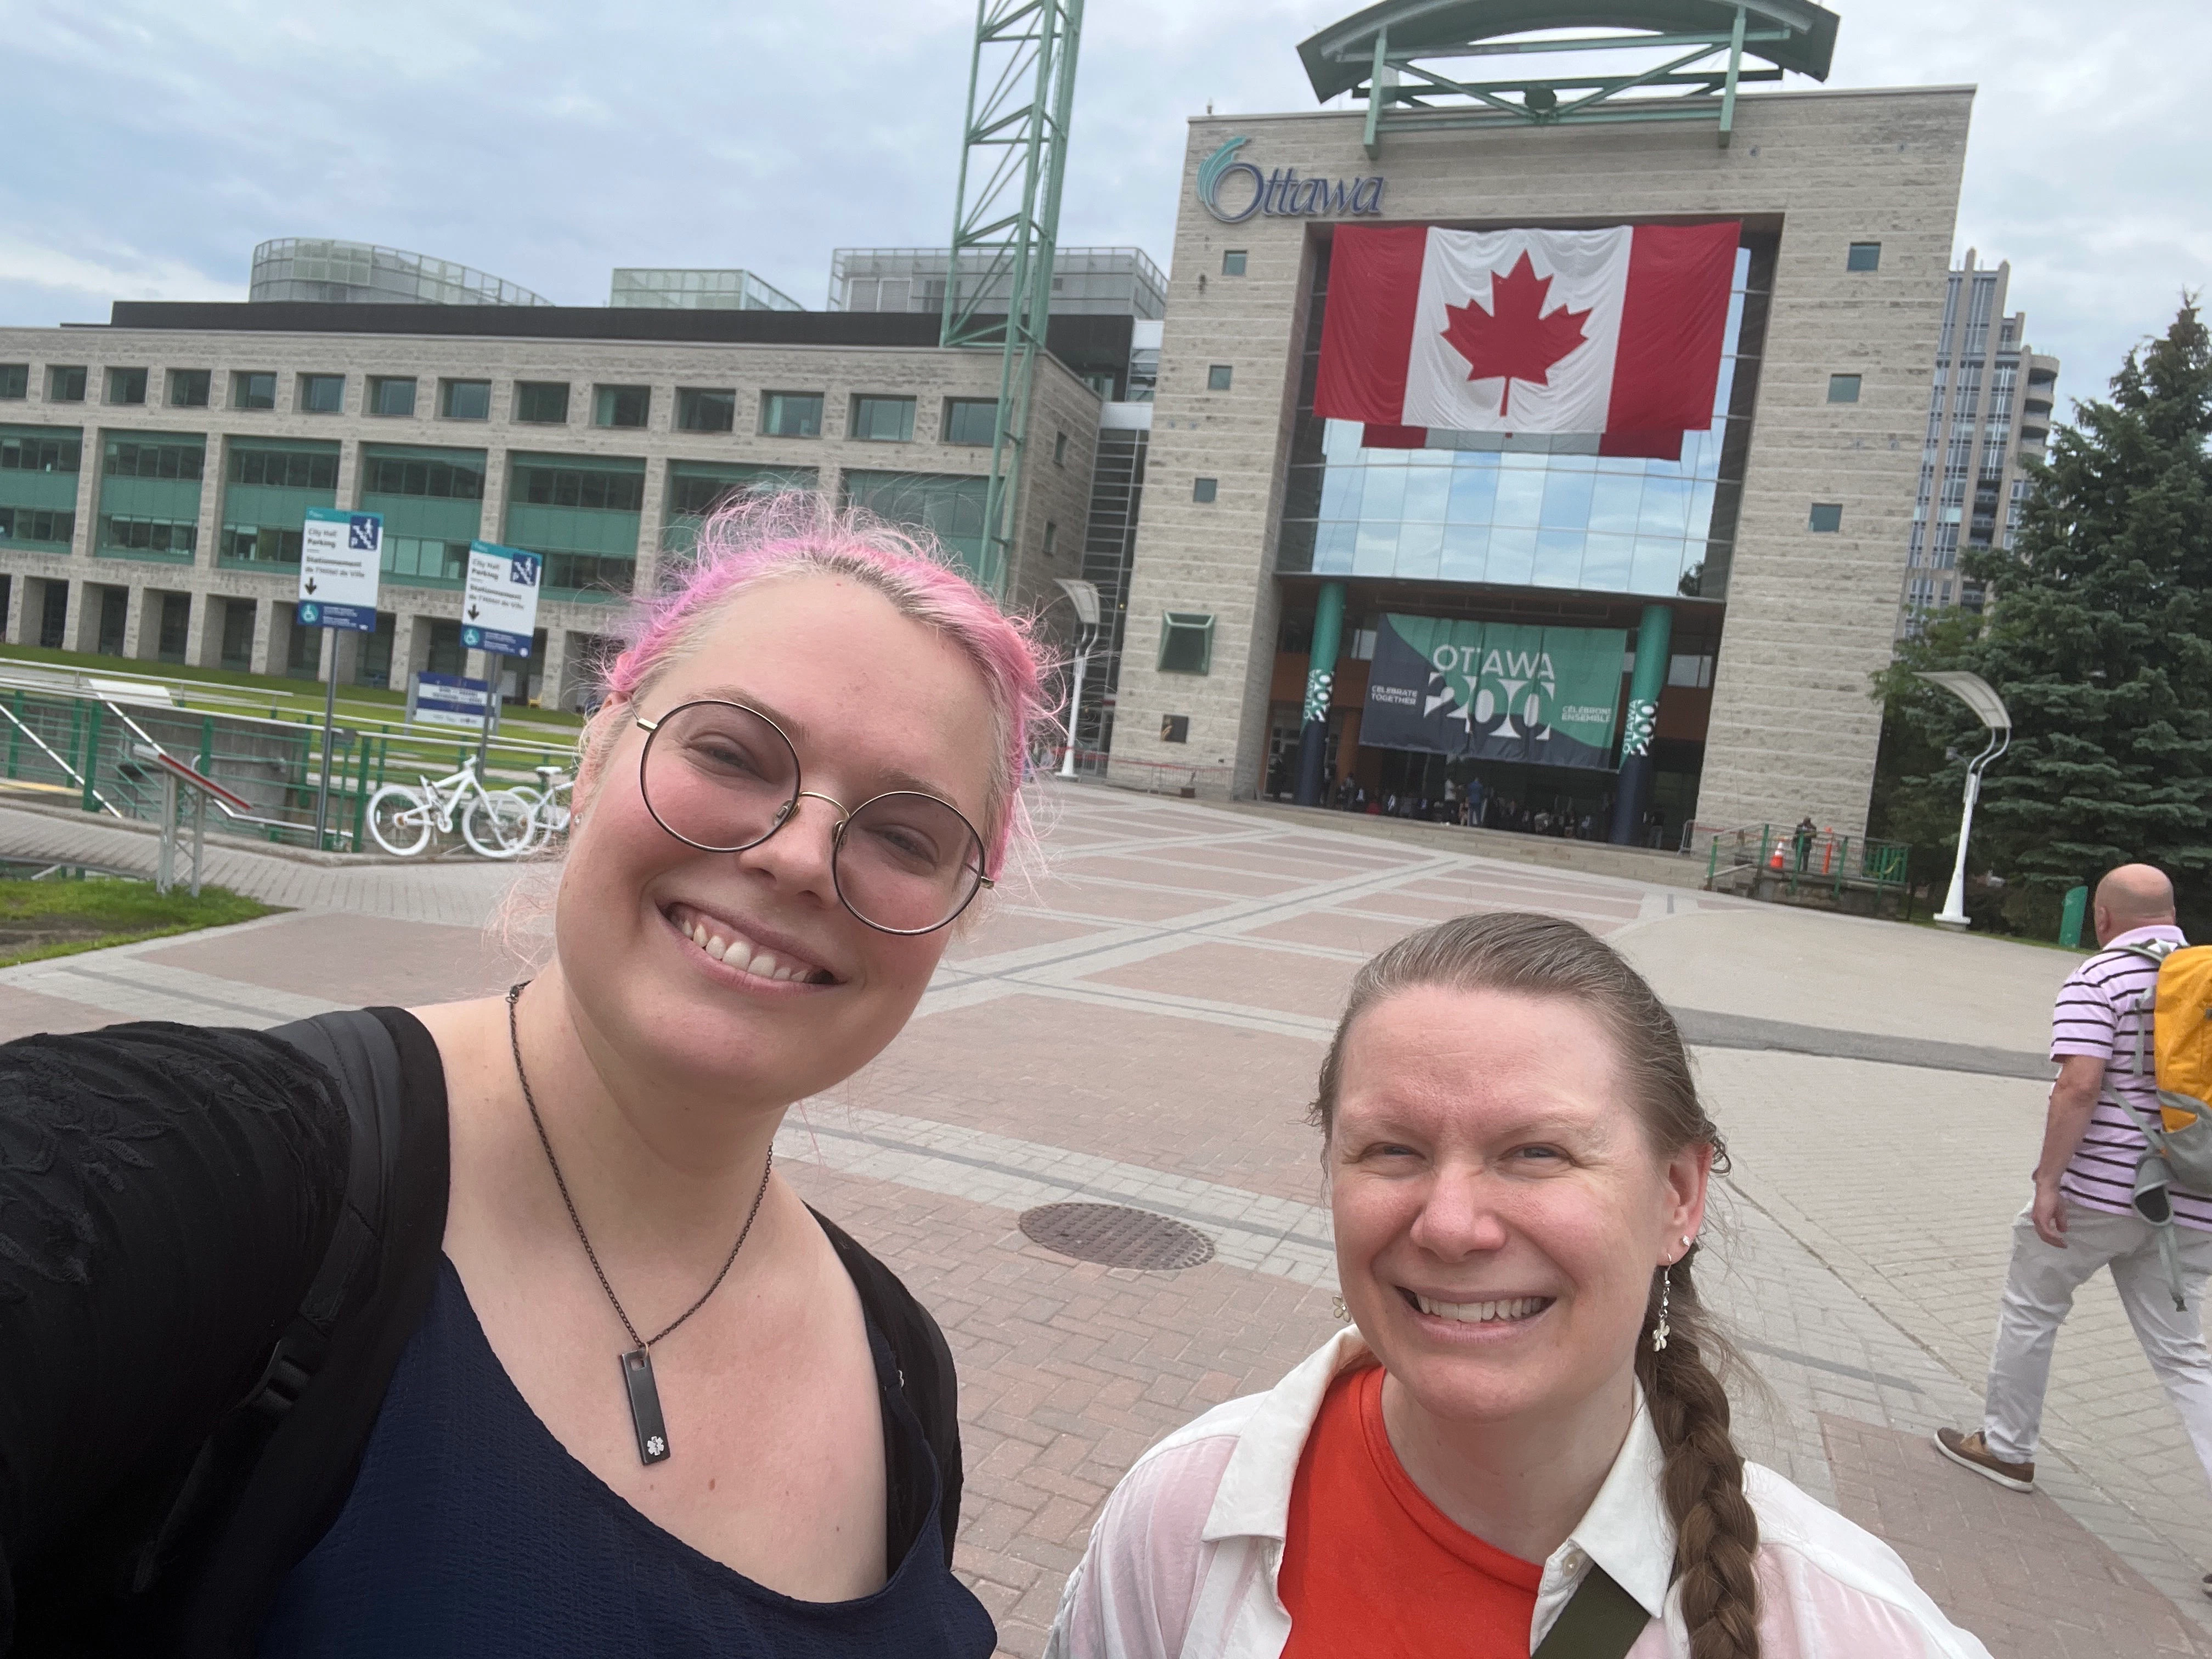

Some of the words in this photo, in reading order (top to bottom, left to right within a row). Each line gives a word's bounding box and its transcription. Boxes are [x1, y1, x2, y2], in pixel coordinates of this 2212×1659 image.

[1206, 160, 1385, 223] Ottawa
[307, 538, 336, 548] Parking
[351, 537, 358, 548] P
[306, 556, 362, 567] Stationnement
[471, 567, 499, 580] Parking
[512, 572, 520, 581] P
[1432, 644, 1555, 681] OTAWA
[1310, 669, 1335, 723] 200
[1372, 685, 1418, 697] CELEBRATE
[1371, 692, 1417, 706] TOGETHER
[1561, 713, 1611, 723] ENSEMBLE
[1630, 699, 1659, 757] 200
